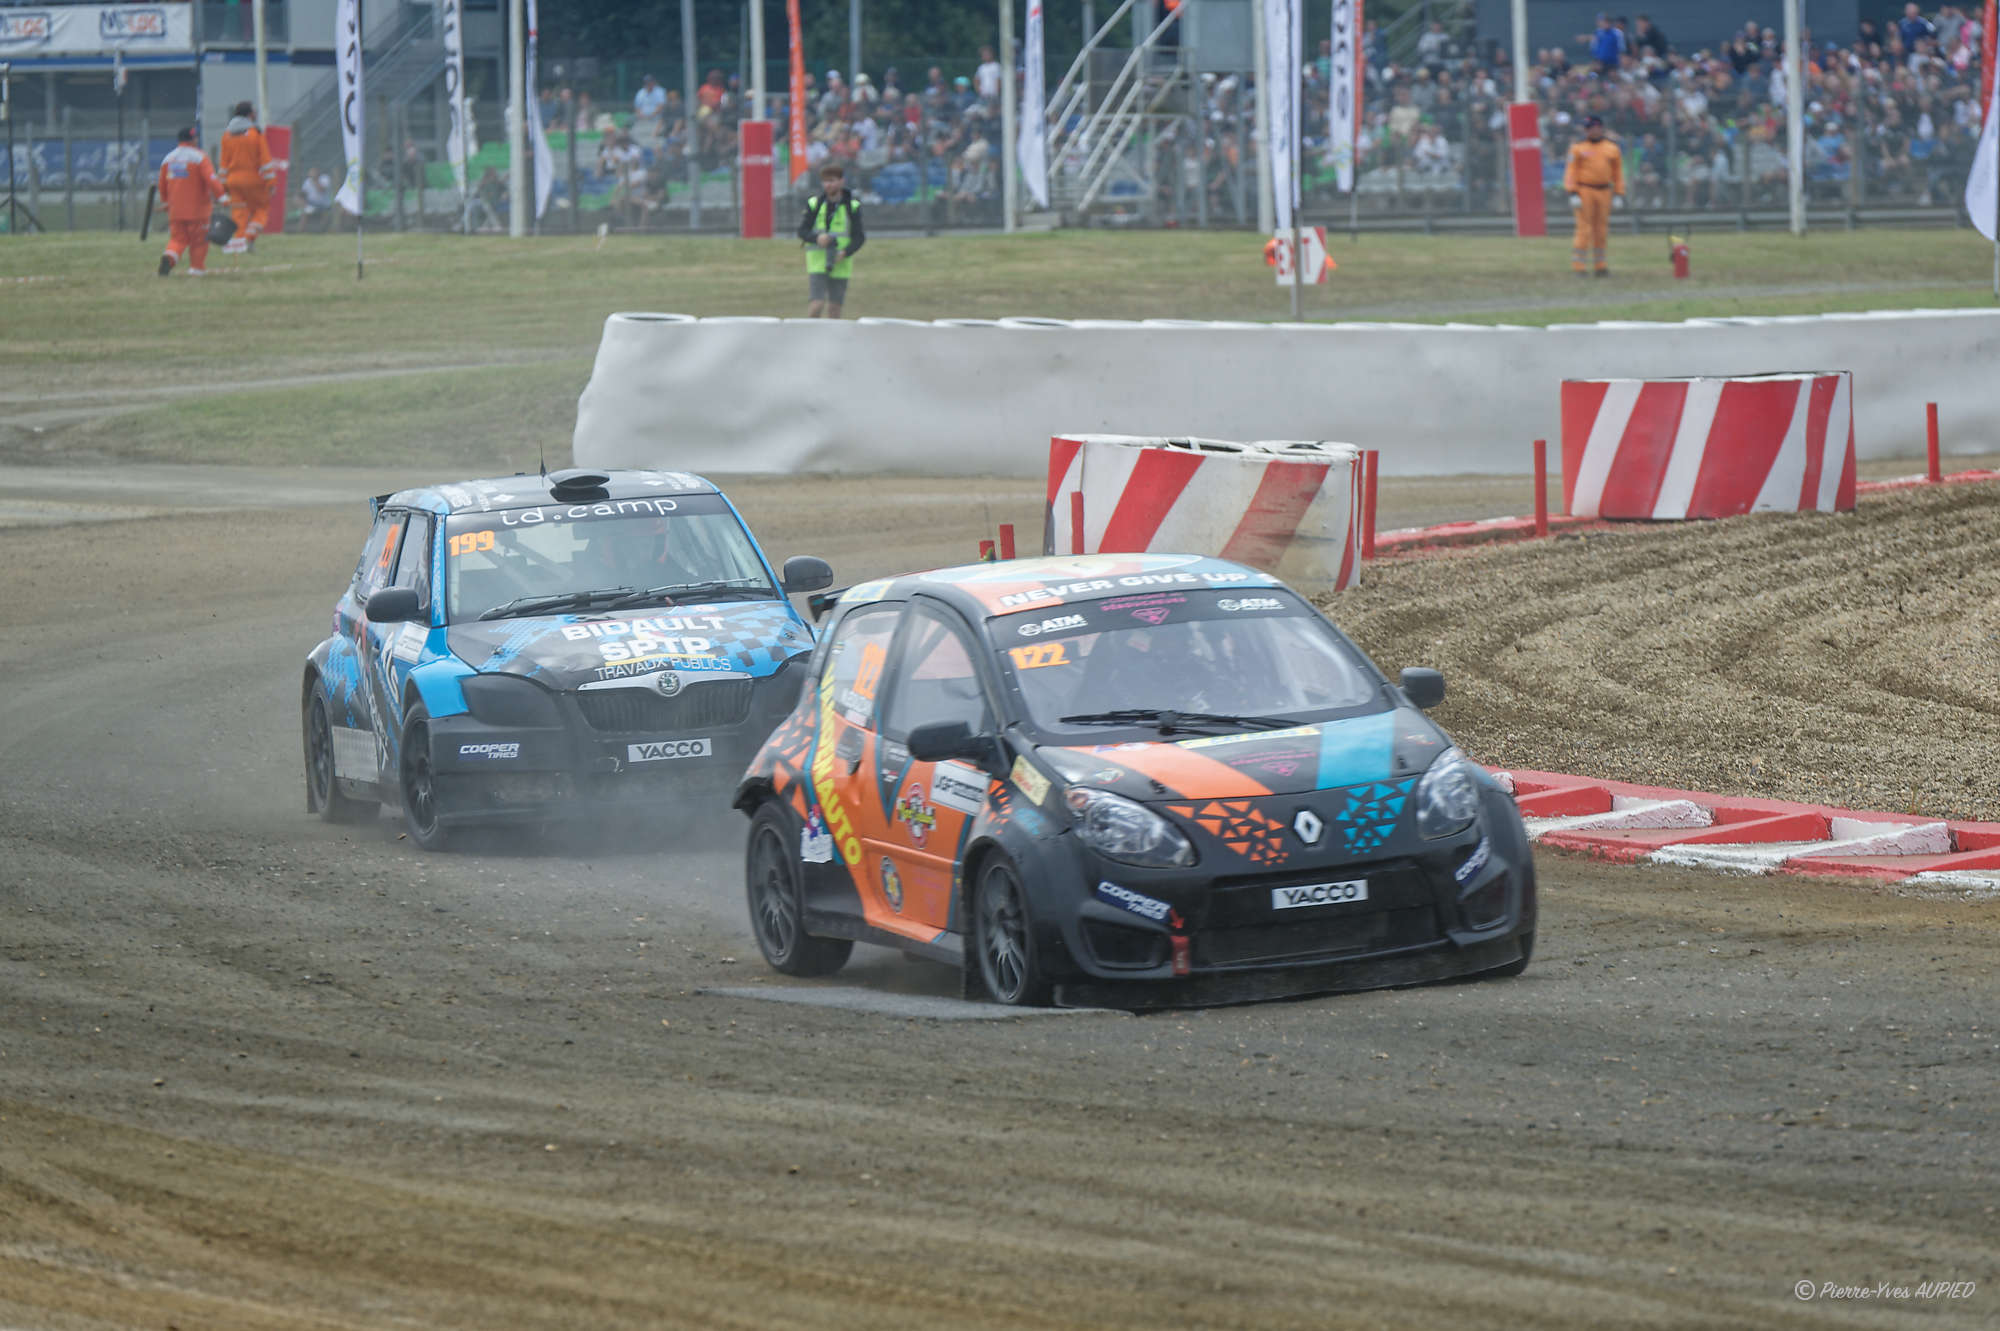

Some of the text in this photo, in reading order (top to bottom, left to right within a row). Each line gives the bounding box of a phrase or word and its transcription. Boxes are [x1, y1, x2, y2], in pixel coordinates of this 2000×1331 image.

[500, 499, 678, 526] id.camp
[448, 530, 495, 557] 199
[1000, 577, 1115, 607] NEVER
[1119, 573, 1197, 587] GIVE
[1202, 572, 1248, 582] UP
[560, 616, 725, 641] BIDAULT
[1042, 614, 1084, 631] ATM
[599, 636, 711, 662] SPTP
[1009, 643, 1071, 670] 122
[594, 655, 732, 681] TRAVAUX PUBLICS
[459, 743, 520, 754] COOPER
[487, 751, 518, 759] TIRES
[636, 741, 704, 760] YACCO
[1098, 881, 1171, 912] COOPER
[1283, 883, 1358, 906] YACCO
